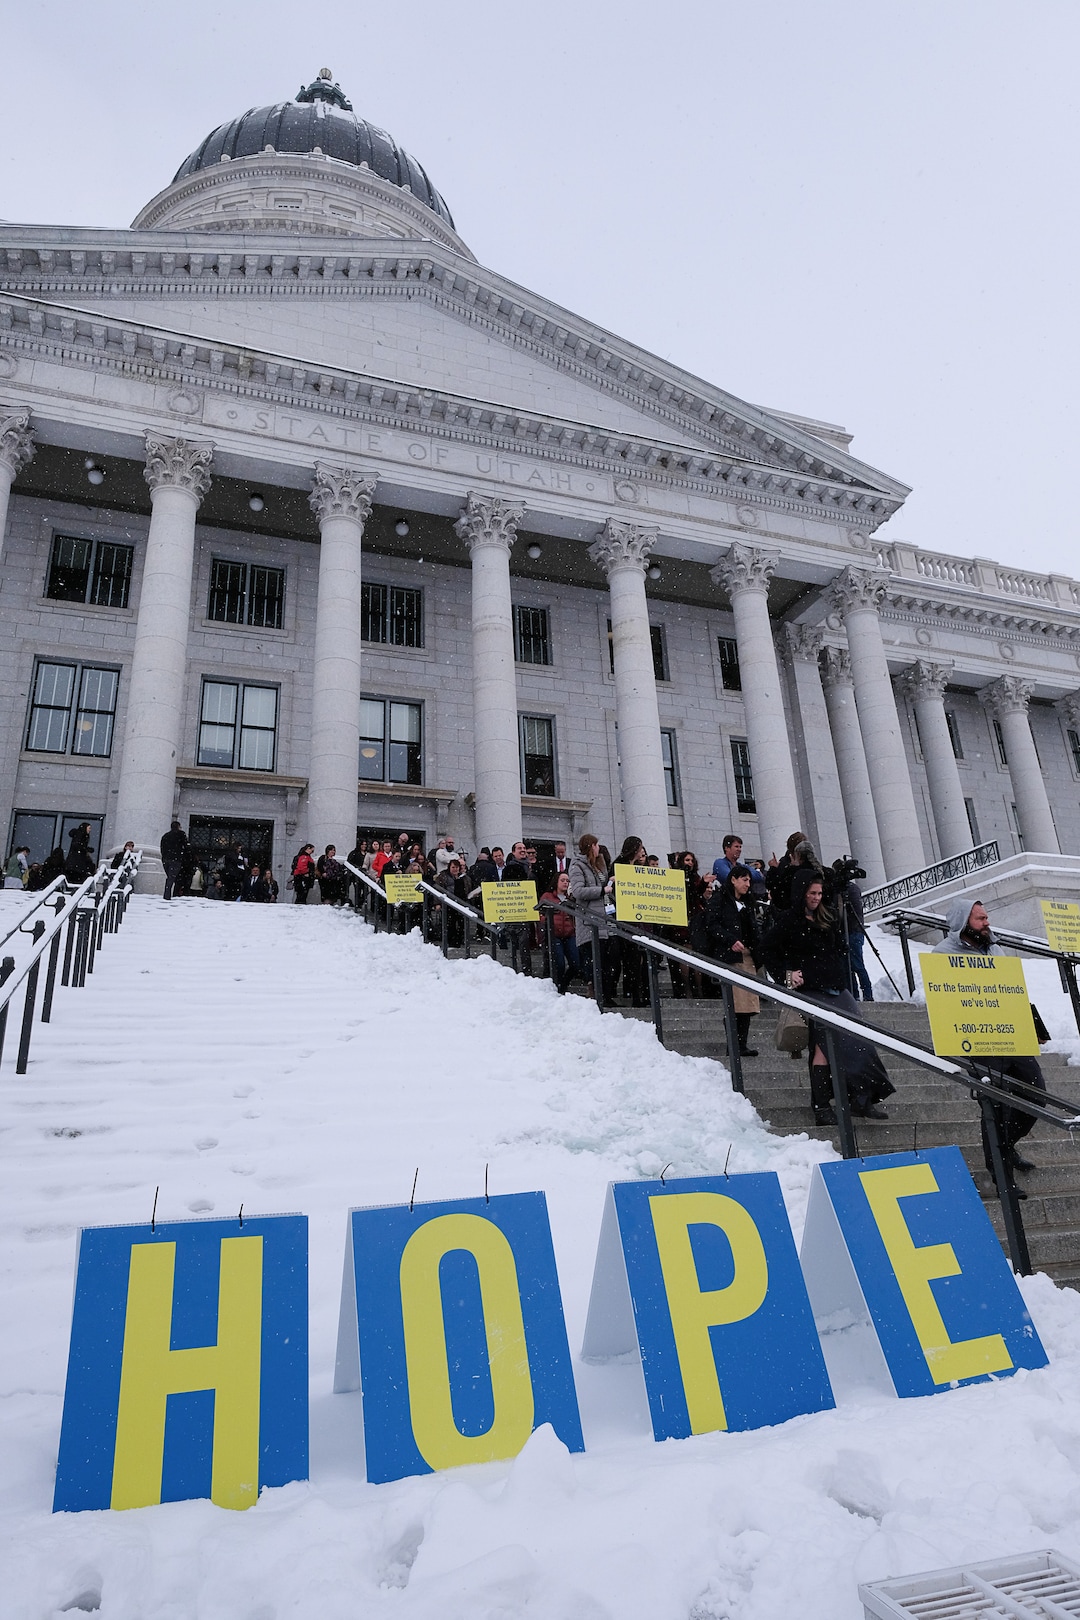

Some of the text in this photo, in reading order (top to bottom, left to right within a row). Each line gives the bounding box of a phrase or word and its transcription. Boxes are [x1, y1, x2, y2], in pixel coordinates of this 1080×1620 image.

[254, 412, 573, 491] STATE OF UTAH
[647, 868, 666, 876] WALK
[632, 904, 673, 913] 1-800-273-8255
[948, 956, 996, 969] WE WALK
[928, 982, 1024, 994] For the family and friends
[961, 998, 1000, 1008] we've lost
[954, 1024, 1015, 1034] 1-800-273-8255
